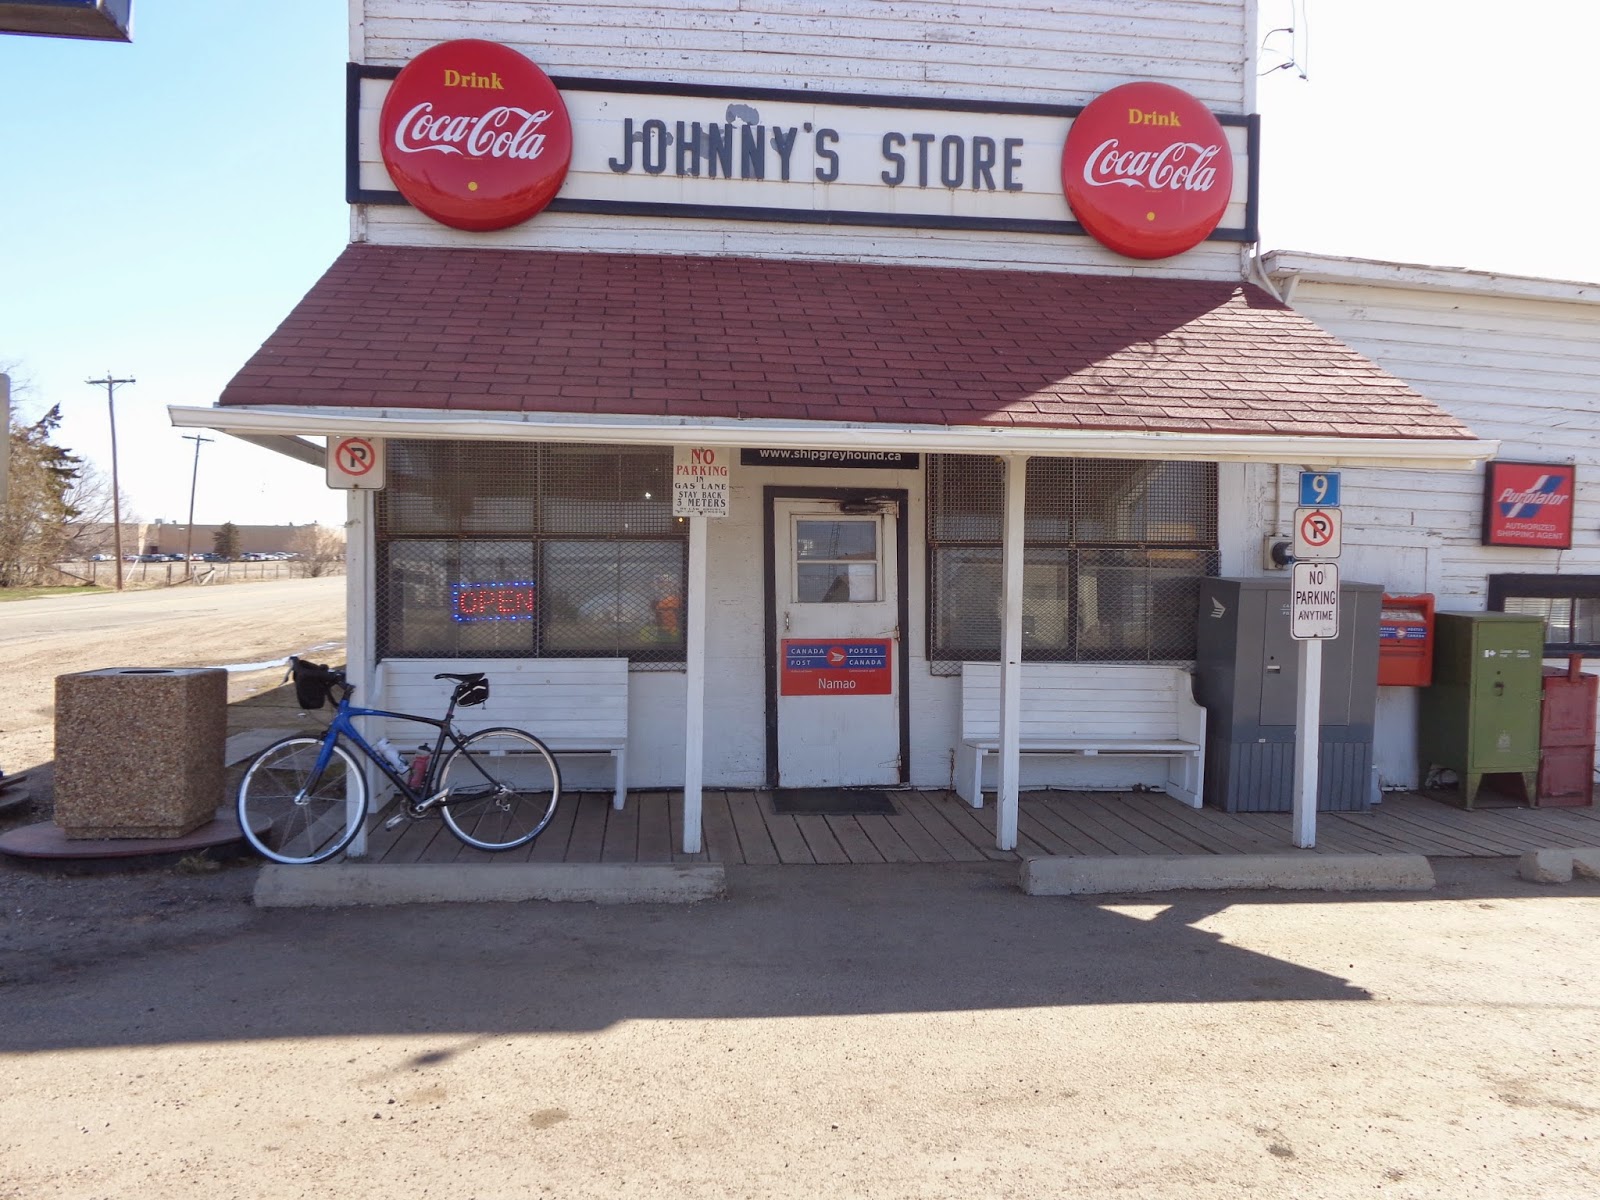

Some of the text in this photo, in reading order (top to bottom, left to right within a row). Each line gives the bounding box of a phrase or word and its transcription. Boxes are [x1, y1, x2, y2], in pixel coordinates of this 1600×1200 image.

[444, 69, 504, 90] Drink
[1128, 108, 1181, 127] Drink
[395, 102, 553, 160] Coca-Cola
[608, 117, 1024, 191] JOHNNY'S STORE
[1083, 138, 1222, 192] Coca-Cola
[691, 448, 715, 465] NO
[759, 449, 902, 461] www.shipgreyhound.ca
[676, 465, 728, 476] PARKING
[674, 482, 727, 491] GAS LANE
[1312, 475, 1328, 504] 9
[678, 491, 722, 499] STAY BACK
[1498, 488, 1569, 505] Purolator
[687, 498, 726, 508] METERS
[1309, 571, 1324, 585] NO
[460, 589, 534, 614] OPEN
[1296, 591, 1336, 605] PARKING
[1298, 610, 1333, 621] ANYTIME
[818, 678, 856, 689] Namao
